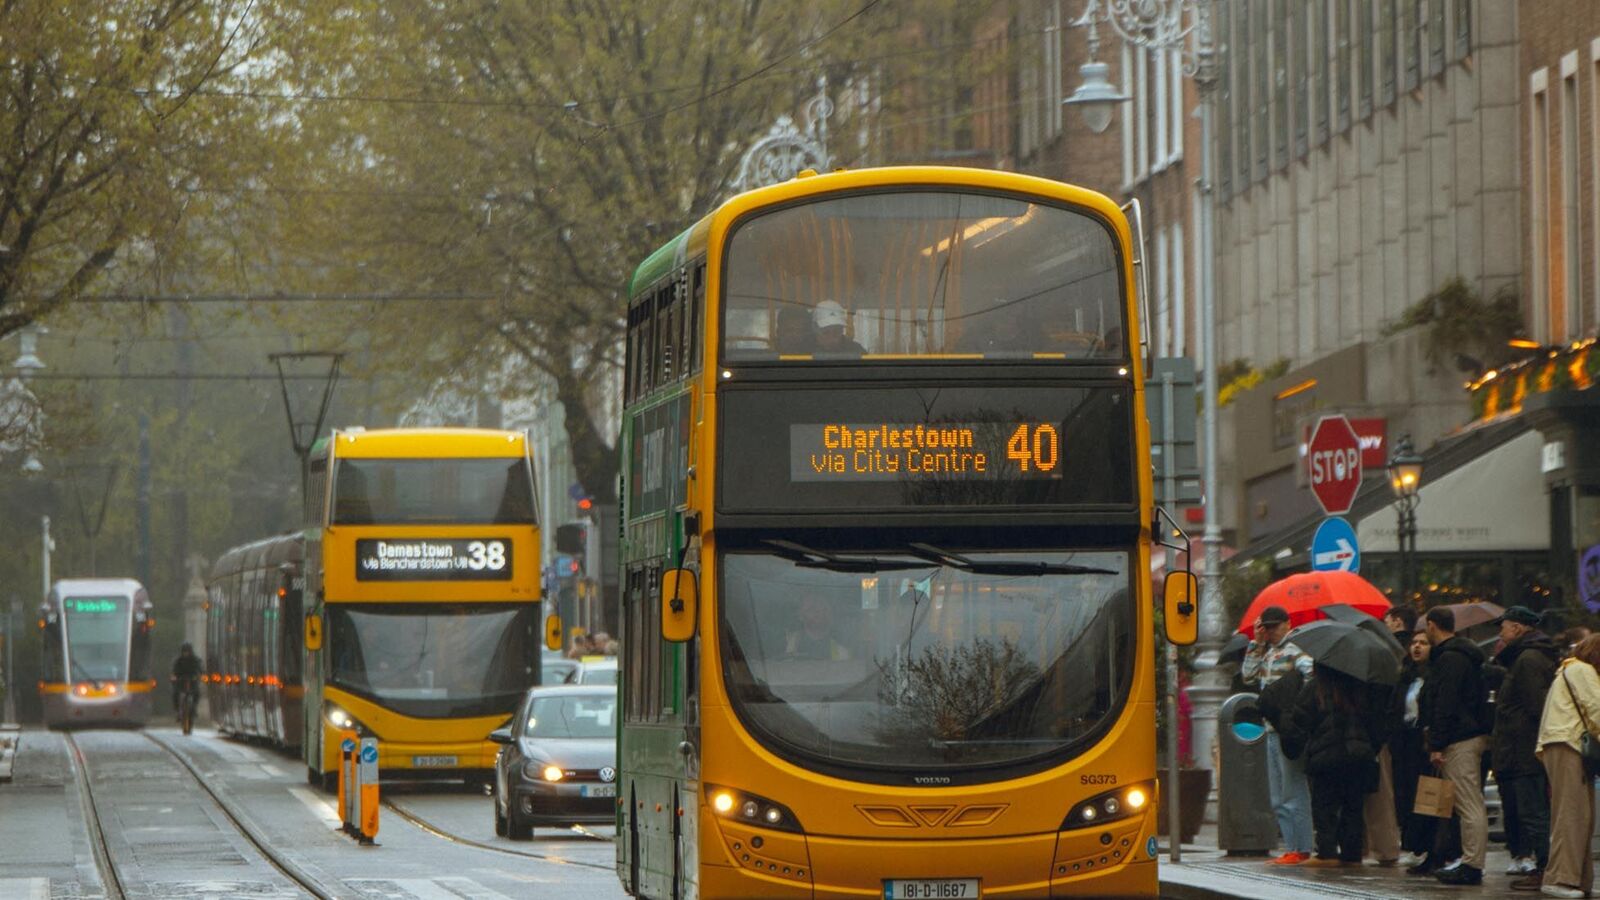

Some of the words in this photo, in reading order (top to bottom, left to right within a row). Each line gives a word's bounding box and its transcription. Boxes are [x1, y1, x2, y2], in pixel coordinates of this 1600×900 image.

[823, 425, 973, 449] Charlestown
[1007, 423, 1059, 471] 40
[810, 450, 845, 473] via
[853, 449, 898, 473] City
[907, 449, 987, 473] Centre
[1313, 448, 1358, 484] STOP
[377, 542, 453, 557] Damastown
[469, 541, 505, 570] 38
[363, 557, 379, 570] via
[380, 556, 453, 570] Blanchardstown
[914, 776, 951, 784] VOLVO
[1080, 774, 1117, 785] SG373
[903, 882, 967, 898] 181-D-11687
